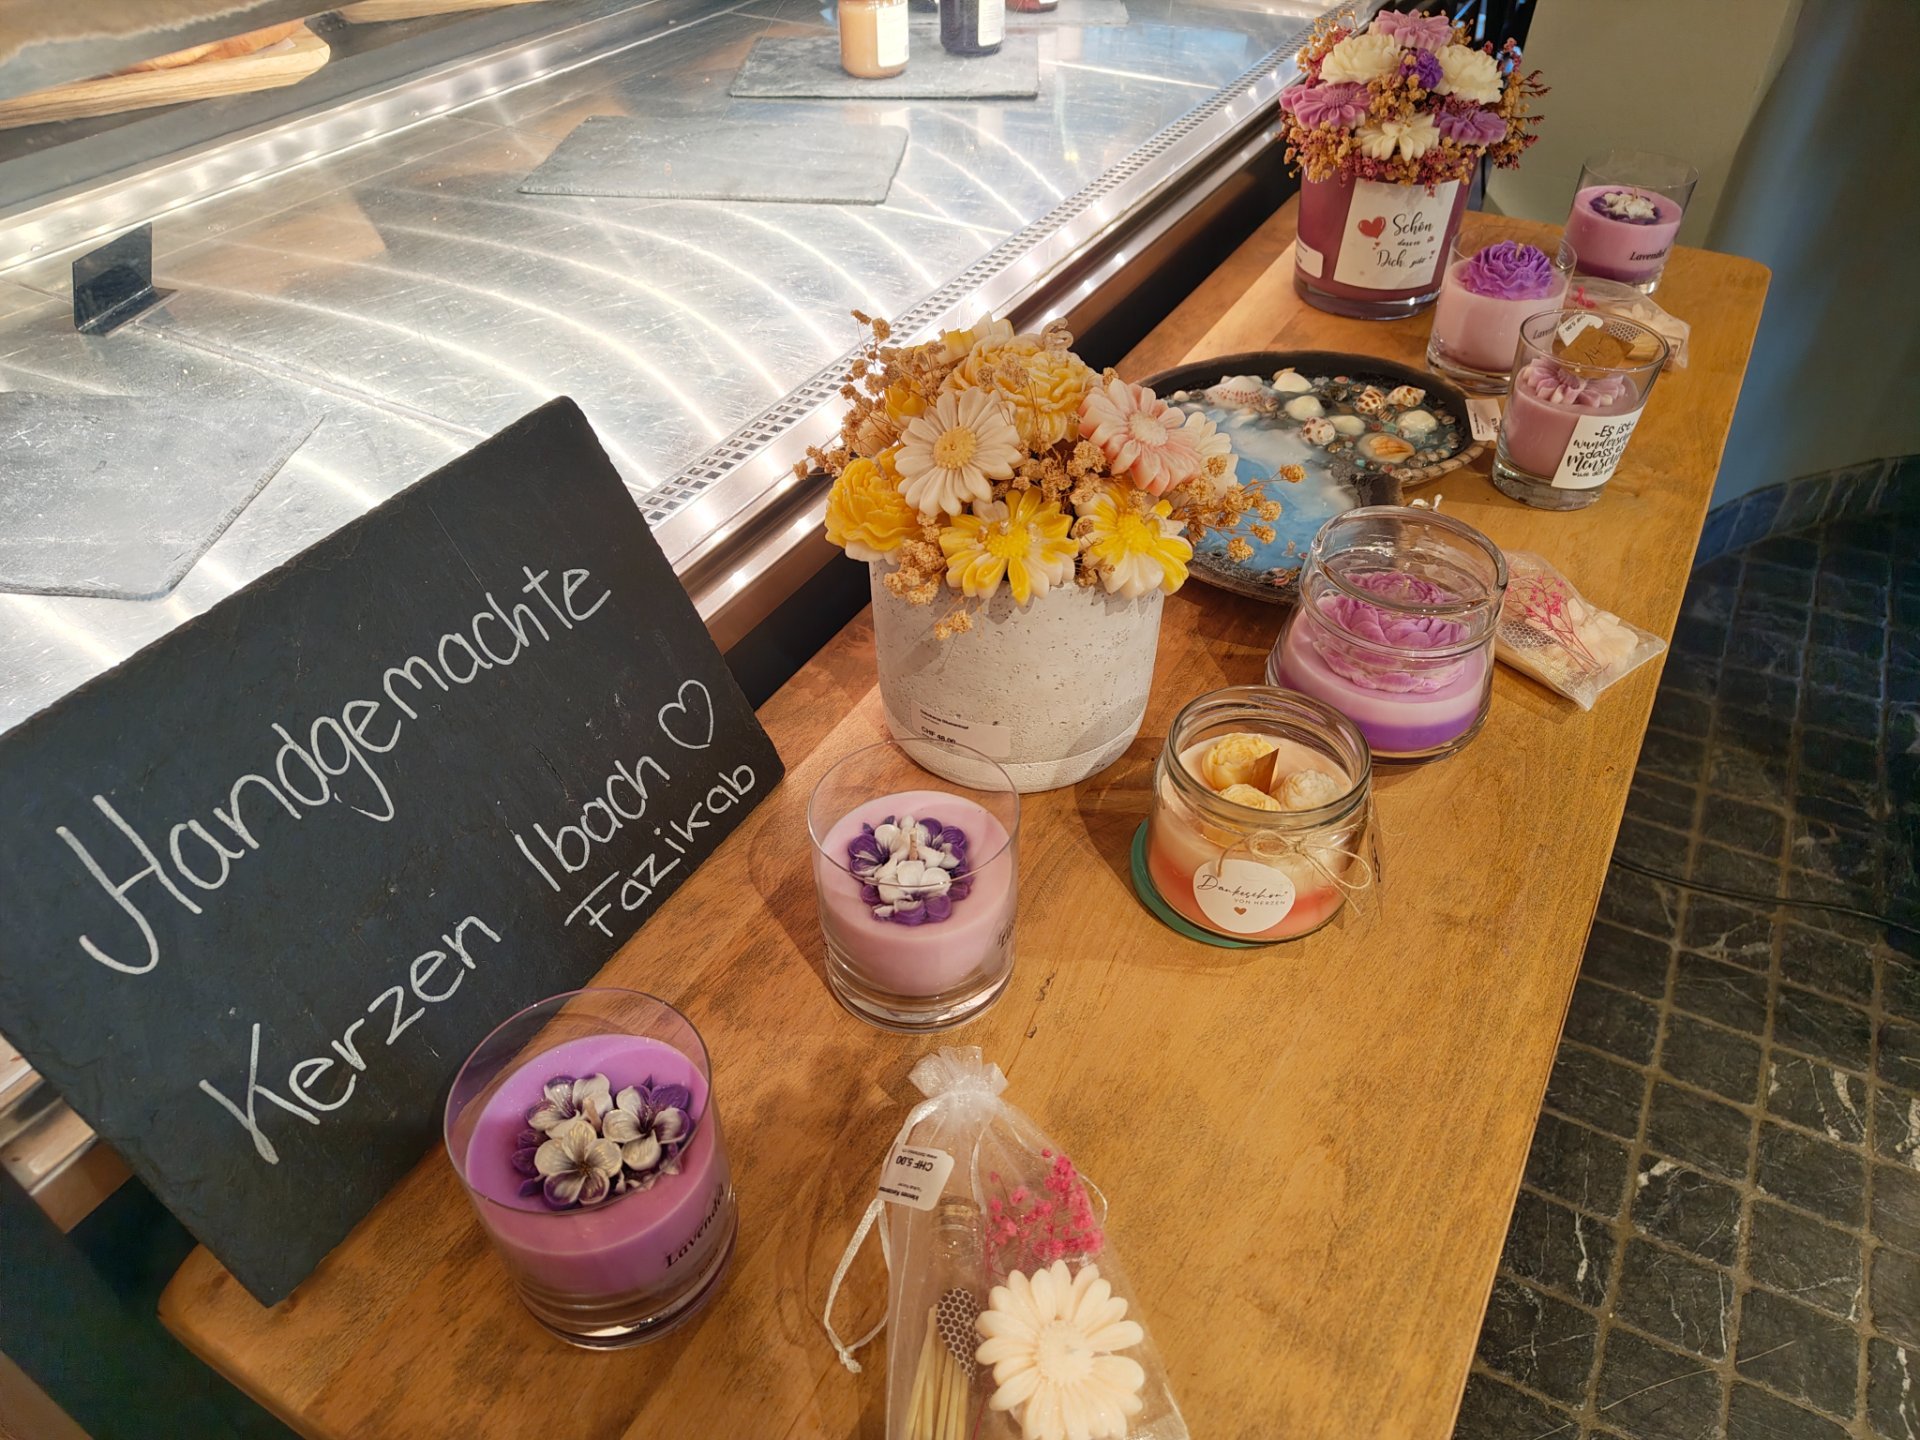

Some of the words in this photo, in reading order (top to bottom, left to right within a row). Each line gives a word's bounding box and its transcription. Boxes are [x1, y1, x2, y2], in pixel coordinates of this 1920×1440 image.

[1392, 211, 1432, 236] Schön
[1376, 248, 1407, 268] Dich
[1585, 447, 1614, 460] dass
[57, 566, 610, 974] Handgemachte
[565, 764, 756, 936] Fazikab
[199, 915, 501, 1164] Kerzen
[515, 754, 669, 892] Ibach
[896, 1155, 914, 1166] 5.00
[913, 1160, 933, 1171] CHF
